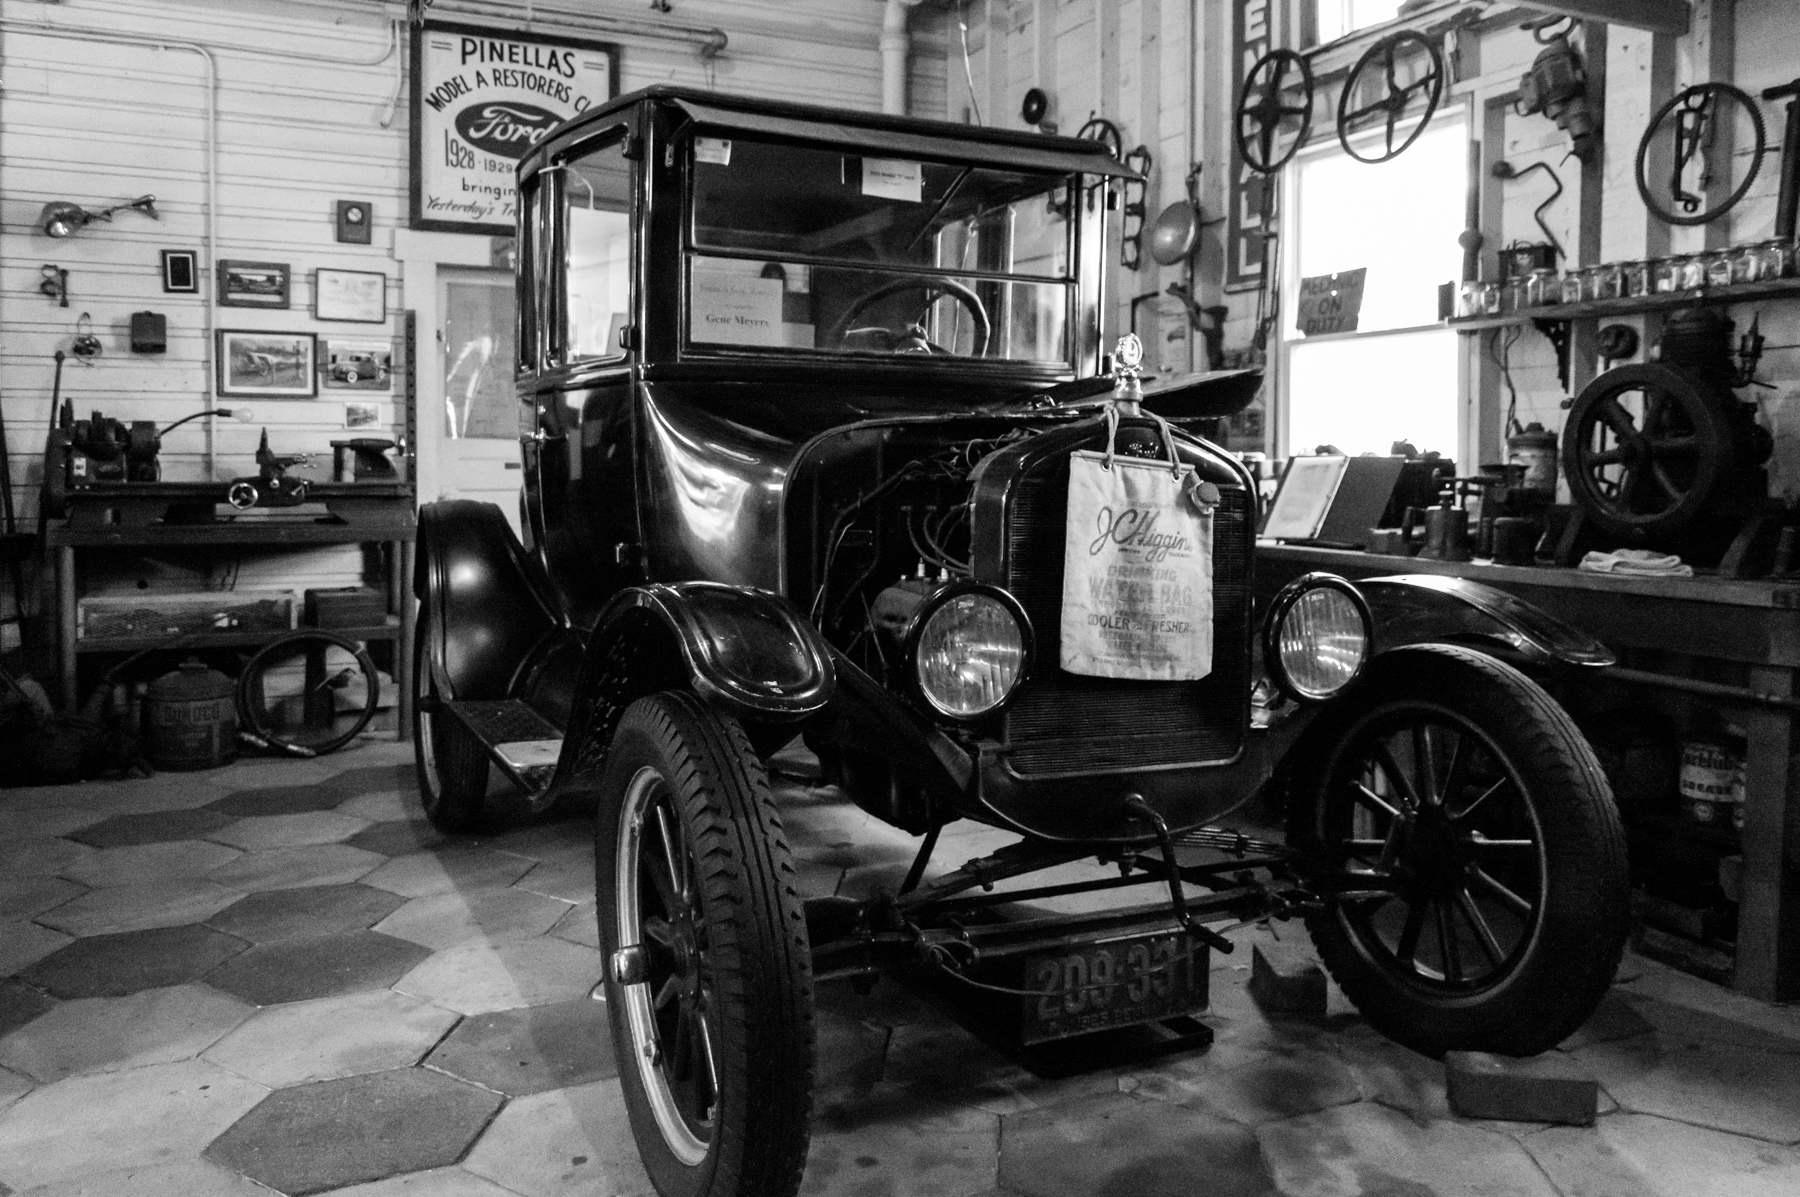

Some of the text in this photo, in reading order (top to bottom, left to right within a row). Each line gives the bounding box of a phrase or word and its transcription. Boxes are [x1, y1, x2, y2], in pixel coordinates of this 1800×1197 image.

[461, 37, 575, 78] PINELLAS
[425, 75, 472, 112] MODEL
[476, 70, 489, 89] A
[493, 69, 572, 103] RESTORERS
[445, 129, 475, 170] 1928
[426, 195, 495, 219] Yesterday's
[1318, 296, 1342, 315] ON
[1305, 316, 1346, 334] DUTY
[1160, 583, 1193, 607] BAG
[1088, 614, 1130, 631] COOLER
